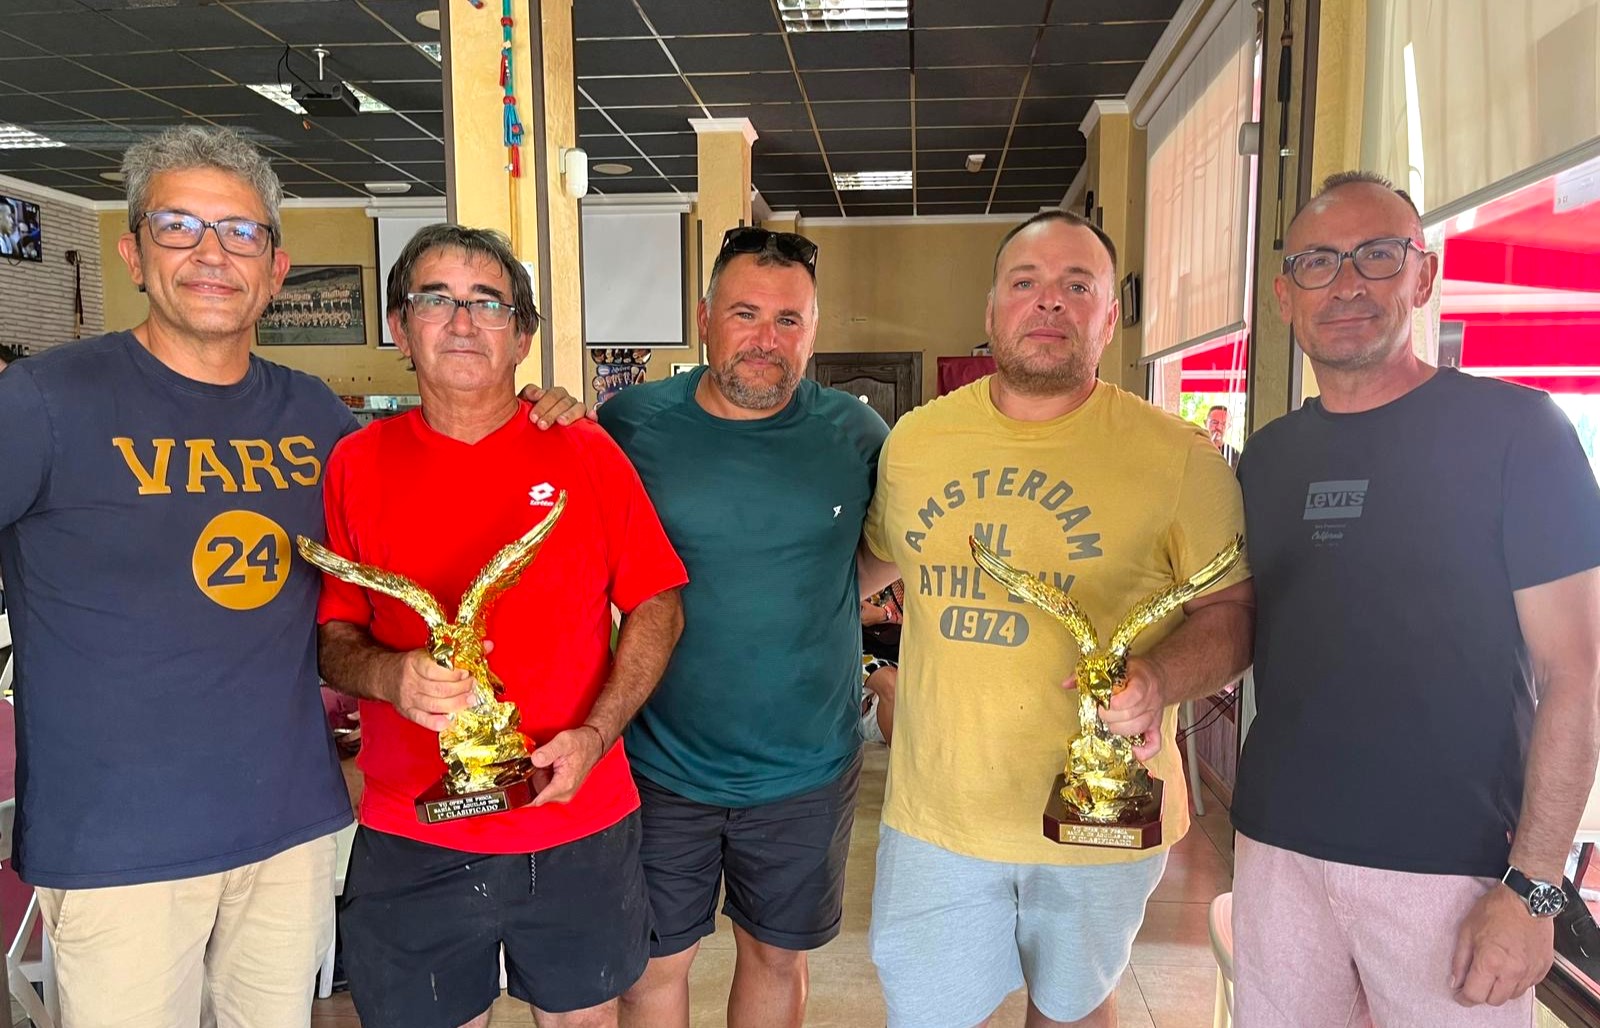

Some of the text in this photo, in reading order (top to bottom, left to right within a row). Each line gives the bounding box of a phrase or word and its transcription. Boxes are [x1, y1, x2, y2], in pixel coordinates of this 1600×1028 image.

[112, 435, 321, 495] VARS
[905, 467, 1103, 561] AMSTERDAM
[974, 523, 1012, 557] NL
[207, 534, 279, 587] 24
[919, 565, 986, 600] ATHL
[949, 609, 1017, 644] 1974
[446, 804, 499, 818] CLASIFICADO
